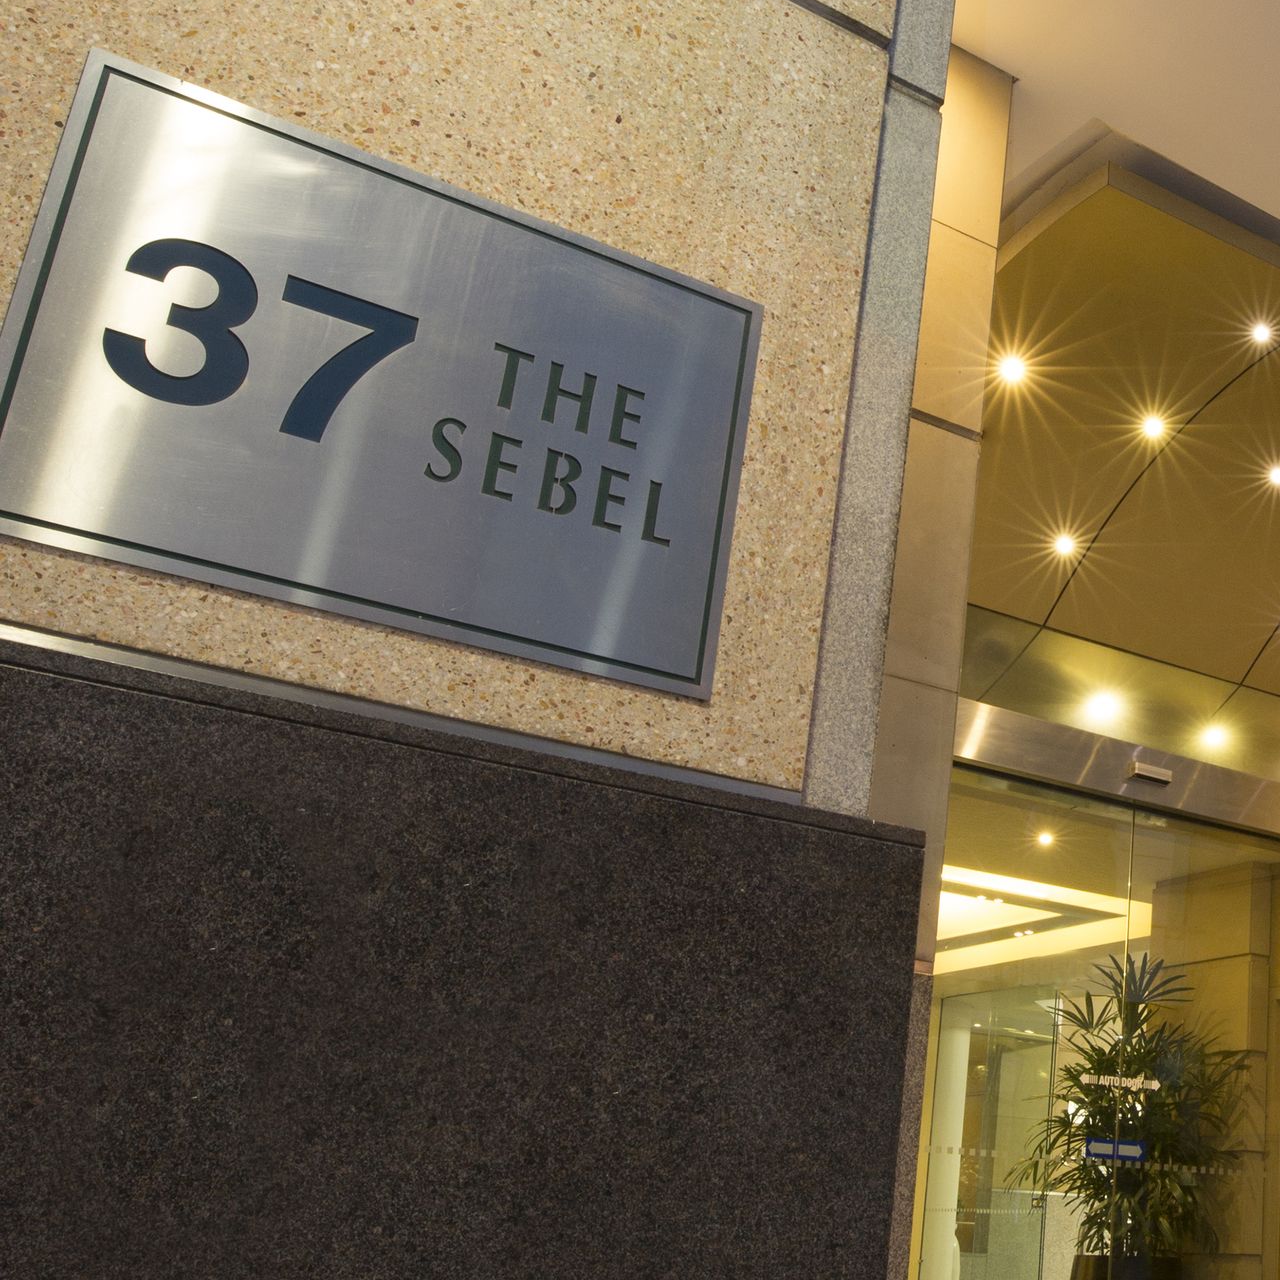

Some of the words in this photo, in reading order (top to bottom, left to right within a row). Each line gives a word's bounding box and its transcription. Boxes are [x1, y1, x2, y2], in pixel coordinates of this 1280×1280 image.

[102, 237, 420, 444] 37
[494, 341, 646, 450] THE
[423, 417, 671, 548] SEBEL
[1099, 1075, 1120, 1087] AUTO
